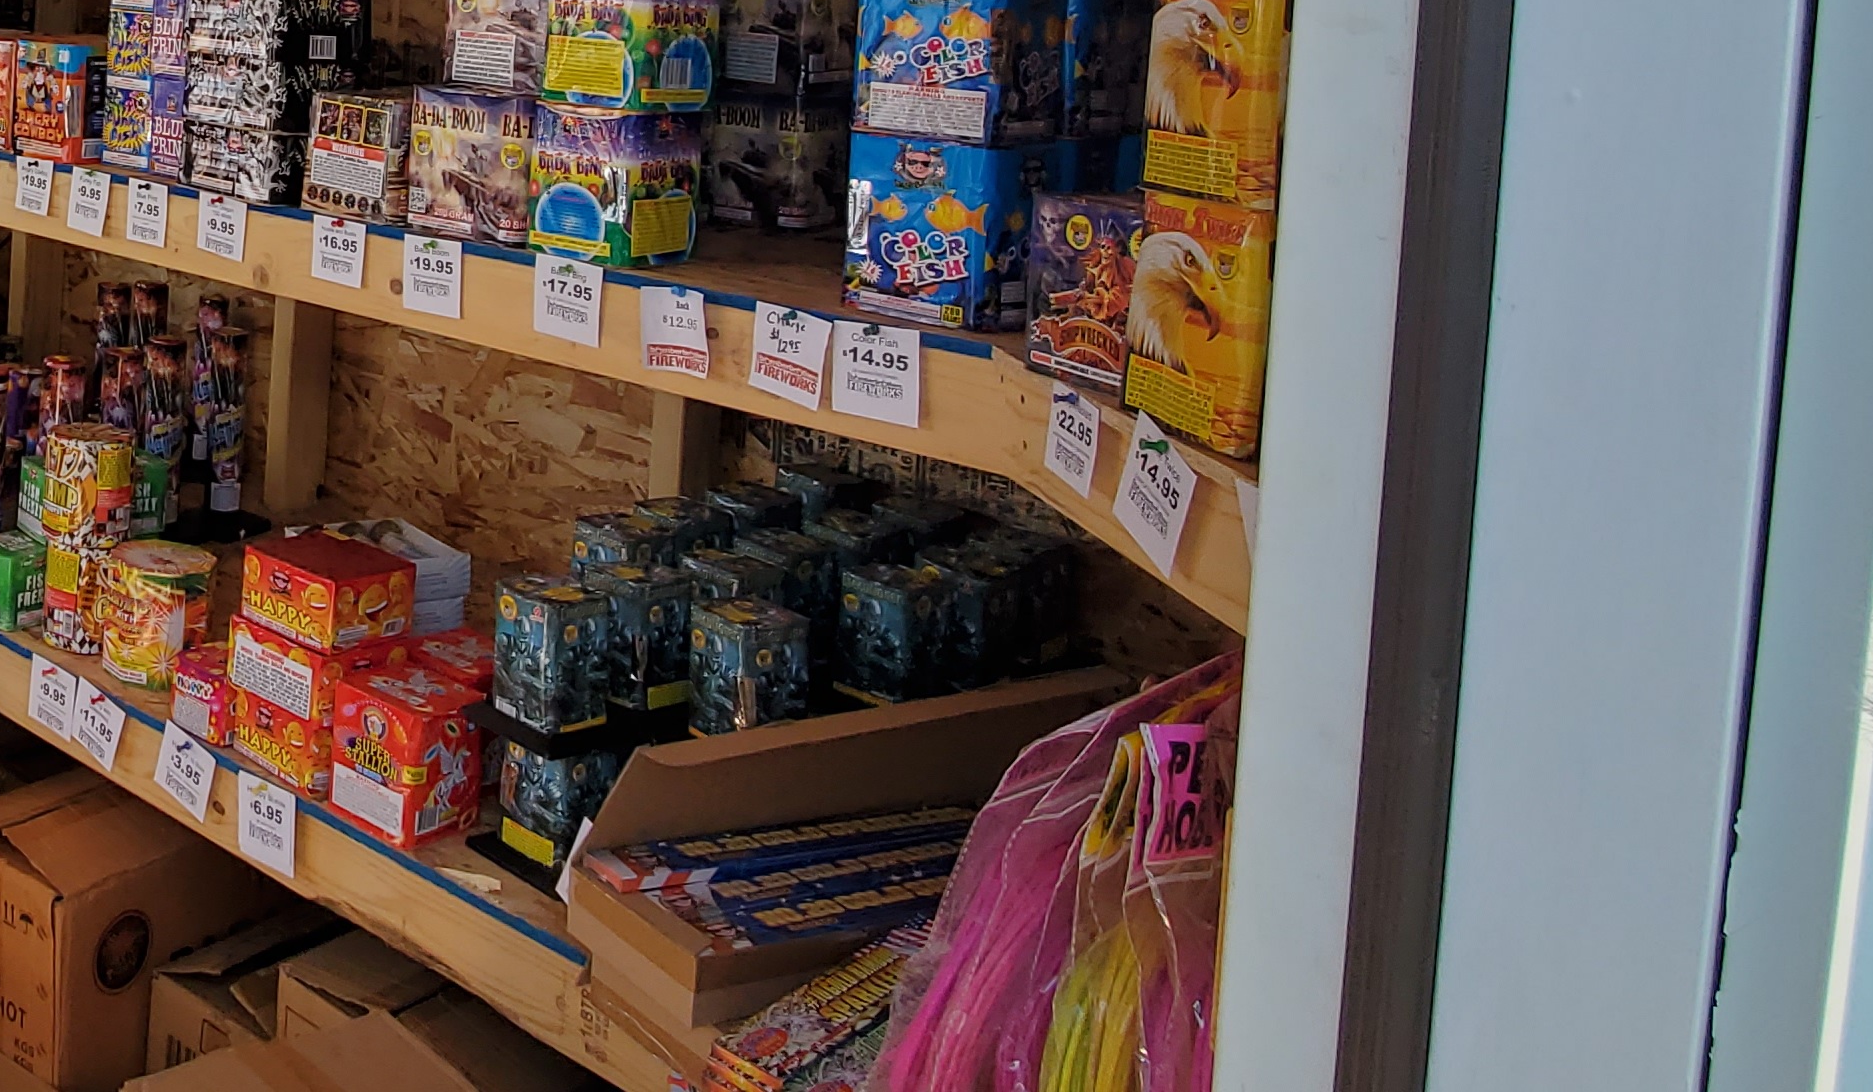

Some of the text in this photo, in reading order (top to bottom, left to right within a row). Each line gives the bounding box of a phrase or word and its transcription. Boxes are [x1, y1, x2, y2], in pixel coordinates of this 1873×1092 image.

[151, 36, 182, 57] PRIN
[909, 35, 989, 67] COLOR
[919, 57, 989, 86] FISH
[17, 111, 59, 127] ANGRY
[412, 102, 486, 134] BA-DA-BOOM
[14, 125, 65, 143] COWBOY
[151, 136, 182, 157] PRIN
[319, 234, 359, 254] $16.95
[880, 230, 969, 264] COLOR
[409, 257, 454, 276] $19.95
[895, 257, 969, 287] FISH
[542, 278, 593, 303] $17.95
[663, 313, 698, 331] $12.95
[851, 332, 899, 349] Color Fish
[649, 354, 707, 374] FIREWORKS
[843, 346, 910, 372] $14.95
[757, 361, 818, 396] FIREWORKS
[249, 589, 312, 629] HAPPY
[40, 682, 66, 707] $9.95
[238, 723, 293, 772] HAPPY
[354, 737, 392, 764] SUPER
[344, 747, 398, 782] STALLION
[249, 799, 284, 826] $6.95
